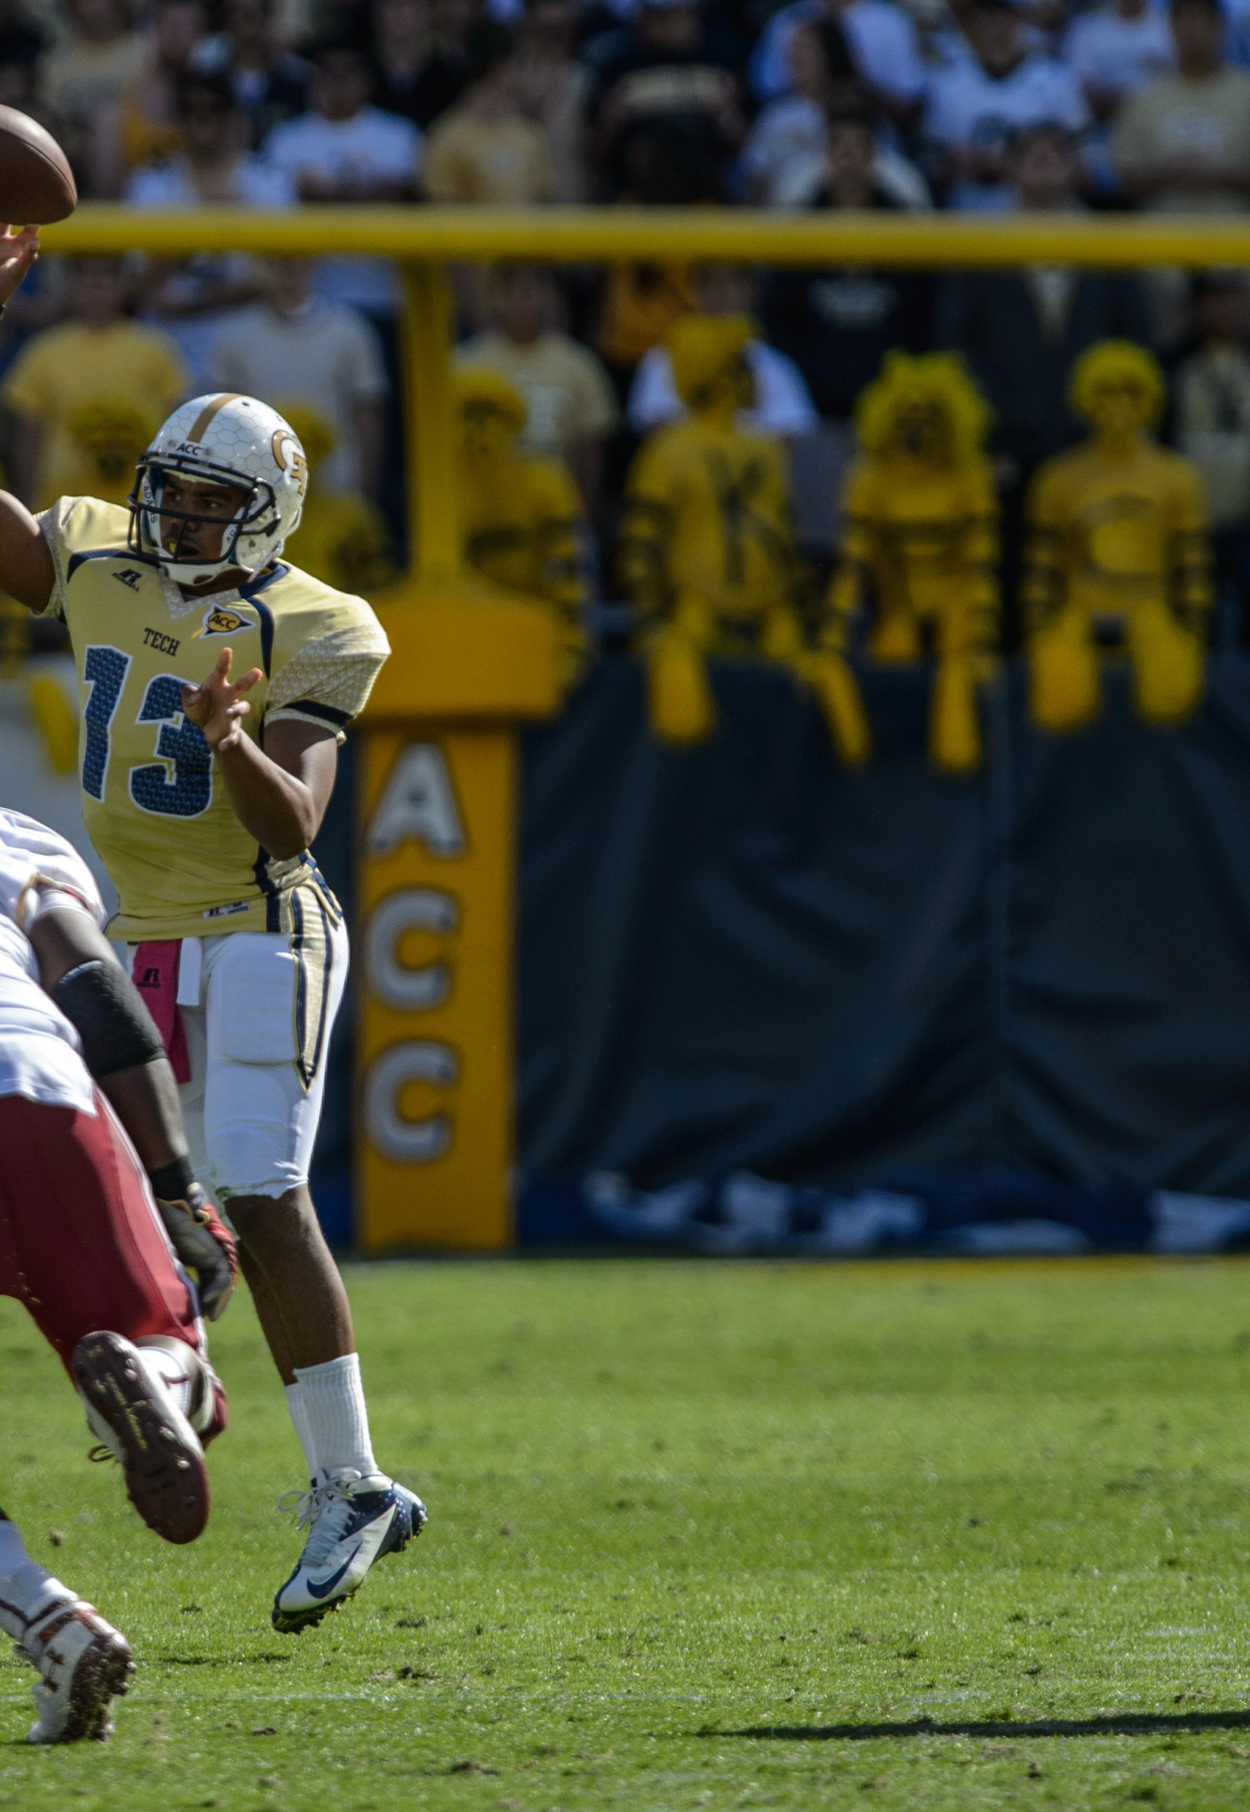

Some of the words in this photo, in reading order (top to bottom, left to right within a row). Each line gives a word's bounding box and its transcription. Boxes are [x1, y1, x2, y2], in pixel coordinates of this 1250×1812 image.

[177, 442, 203, 456] ACC
[210, 614, 237, 630] ACC
[143, 627, 181, 656] TECH
[81, 644, 214, 820] 13
